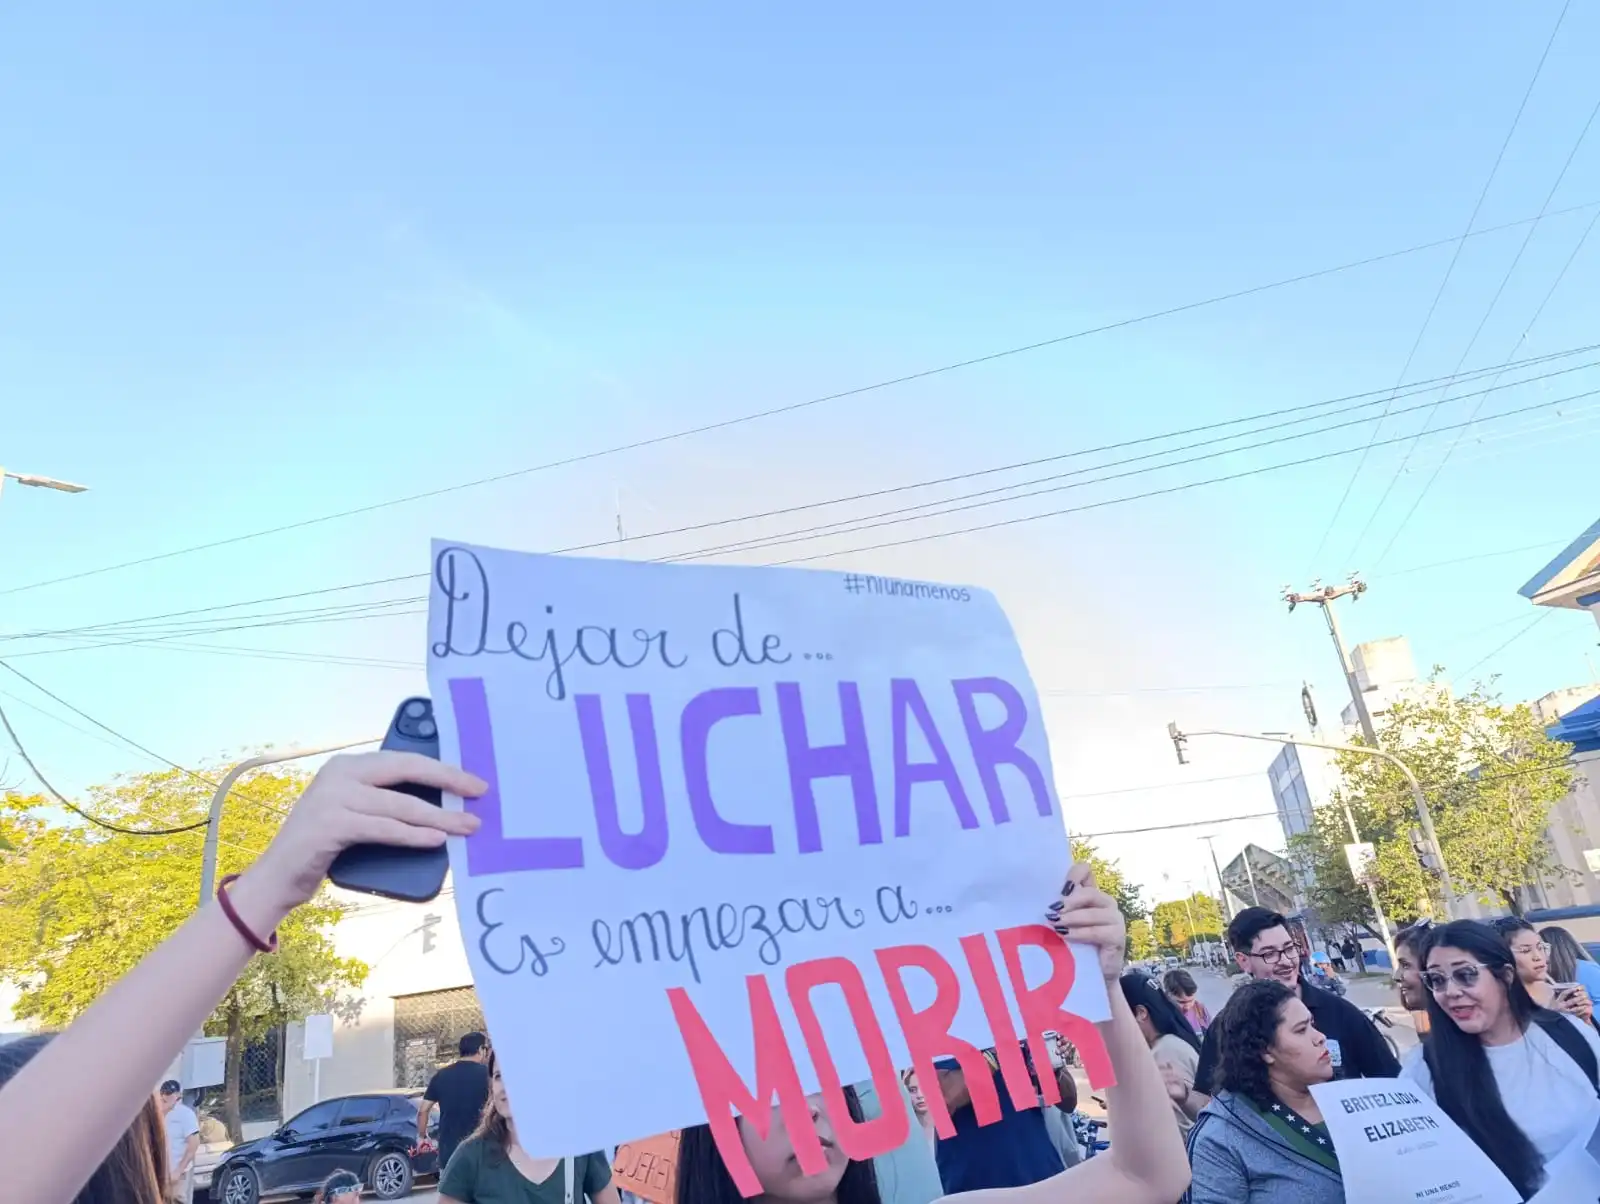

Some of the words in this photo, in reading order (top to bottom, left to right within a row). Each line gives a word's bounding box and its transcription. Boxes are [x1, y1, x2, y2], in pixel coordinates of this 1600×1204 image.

[432, 546, 688, 700] Dejar
[711, 594, 834, 667] de...
[448, 676, 1053, 877] LUCHAR
[476, 887, 566, 977] Es
[593, 894, 865, 983] empezar
[665, 924, 1119, 1199] MORIR
[1340, 1093, 1393, 1114] BRITEZ
[1388, 1091, 1422, 1105] LIDIA
[1363, 1115, 1440, 1143] ELIZABETH
